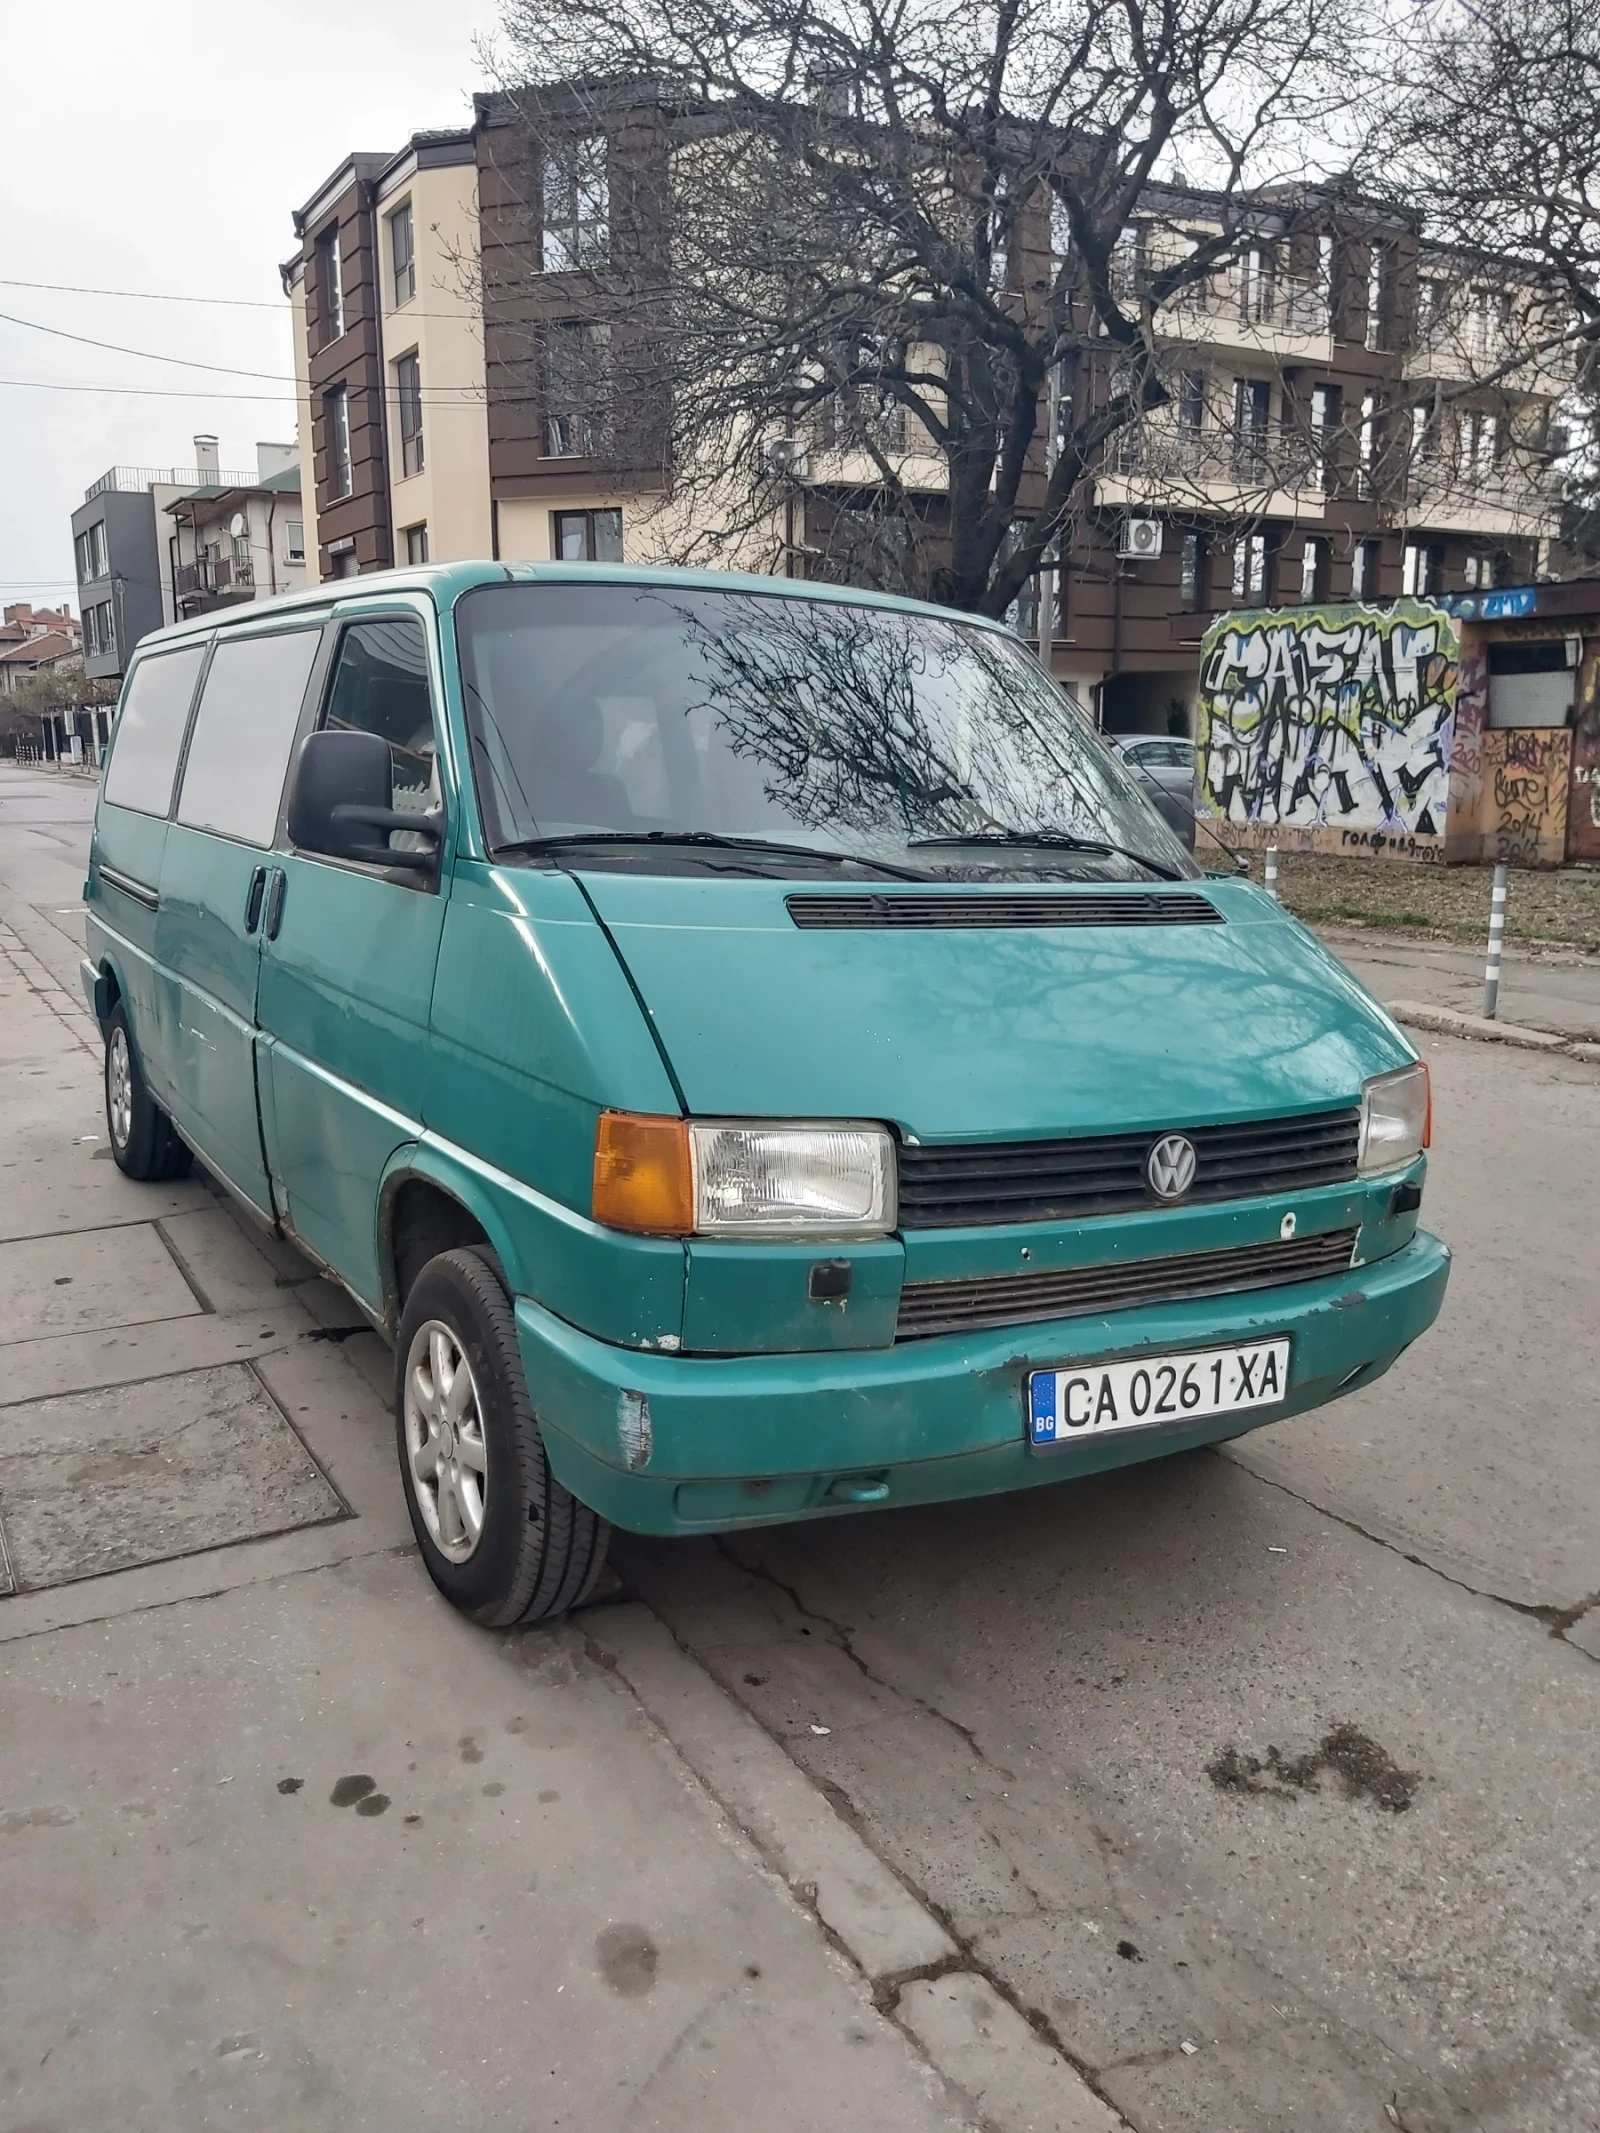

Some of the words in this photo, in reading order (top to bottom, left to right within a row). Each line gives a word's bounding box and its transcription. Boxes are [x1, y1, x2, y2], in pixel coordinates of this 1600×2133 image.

[1496, 812, 1543, 844] 2014
[1064, 1374, 1118, 1427] CA
[1130, 1358, 1222, 1416] 0261
[1234, 1350, 1278, 1401] XA
[1036, 1416, 1054, 1432] BG
